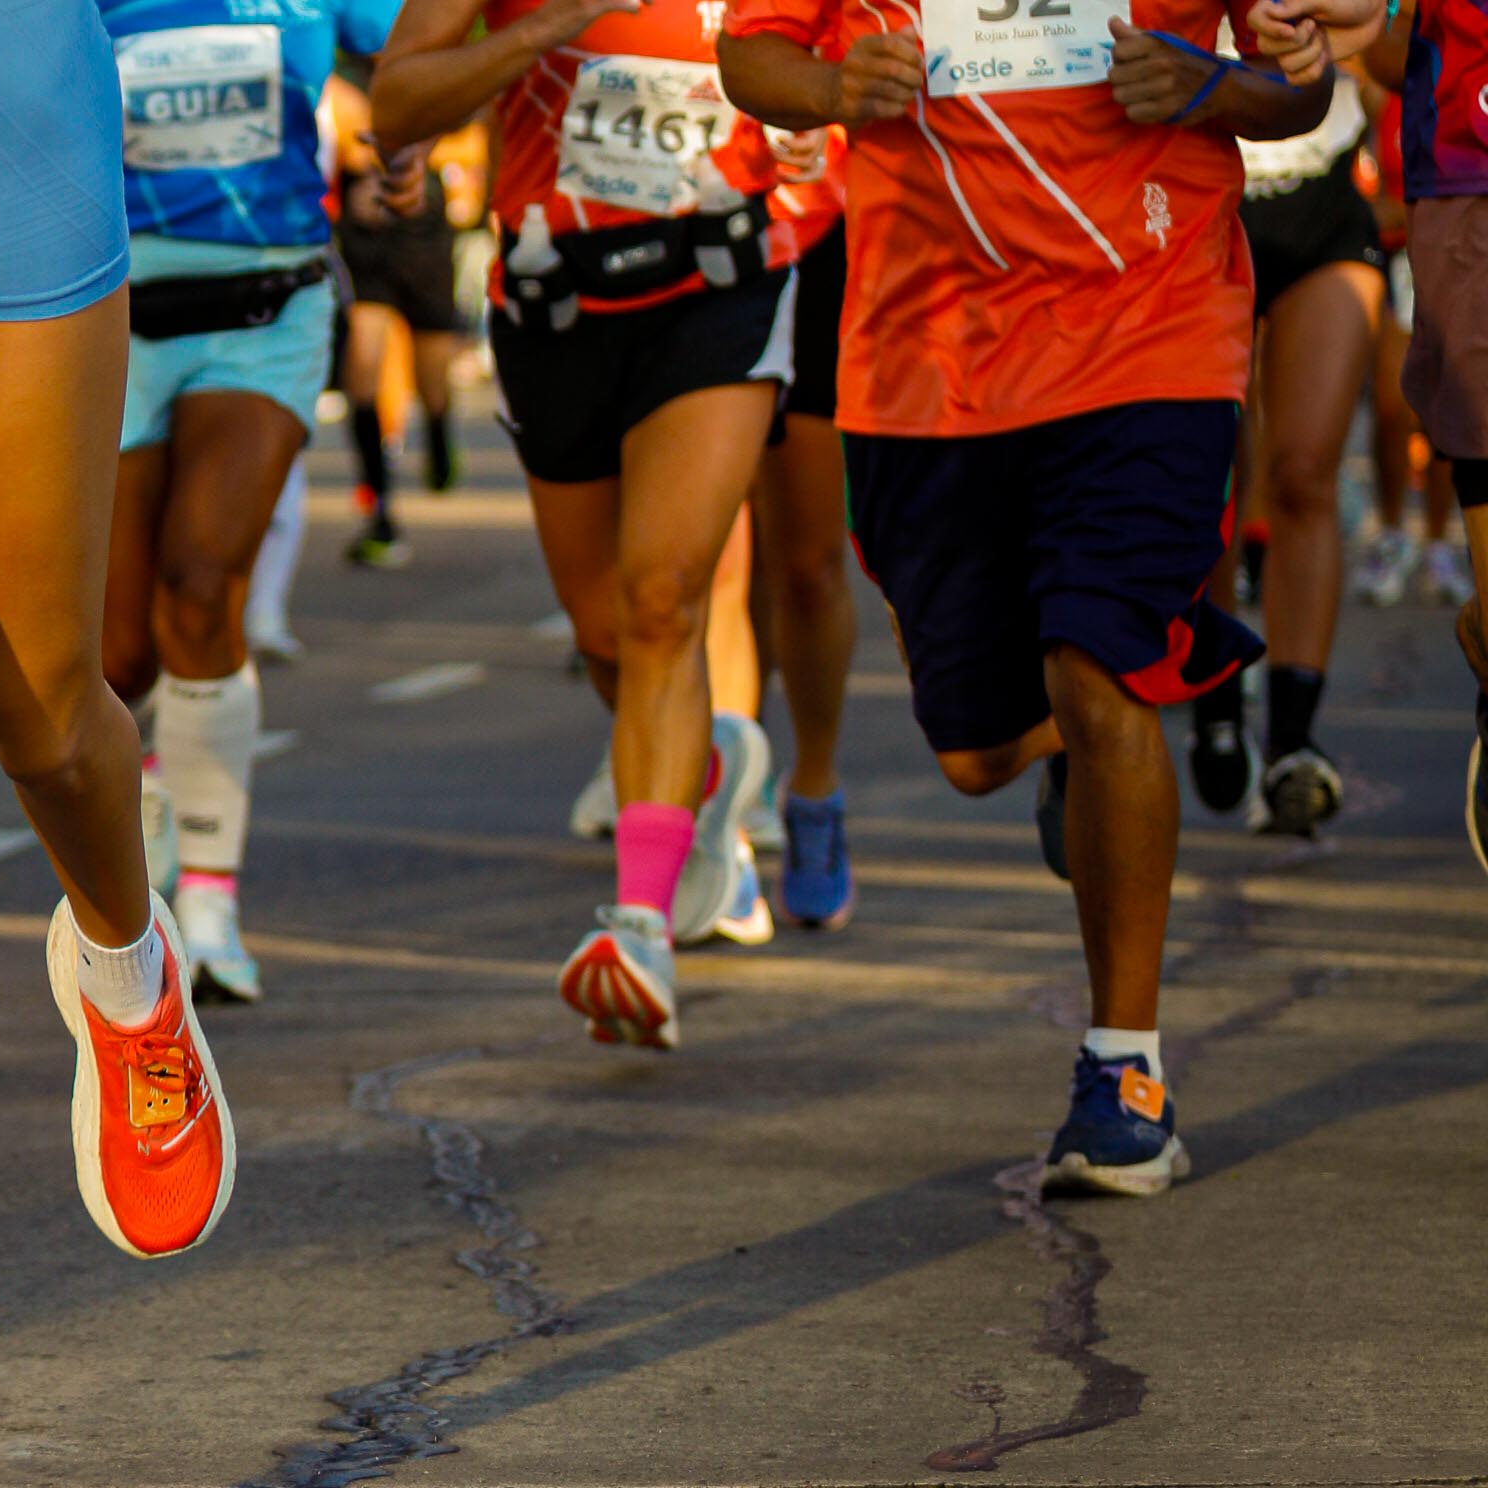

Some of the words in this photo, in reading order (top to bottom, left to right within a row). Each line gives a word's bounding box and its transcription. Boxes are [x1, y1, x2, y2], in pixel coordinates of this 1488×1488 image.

[974, 30, 1008, 44] Rojas
[1012, 27, 1039, 40] Juan
[1043, 24, 1076, 37] Pablo
[598, 69, 638, 92] 15K
[949, 56, 1013, 83] osde
[144, 84, 249, 123] GUIA
[570, 99, 718, 158] 1461
